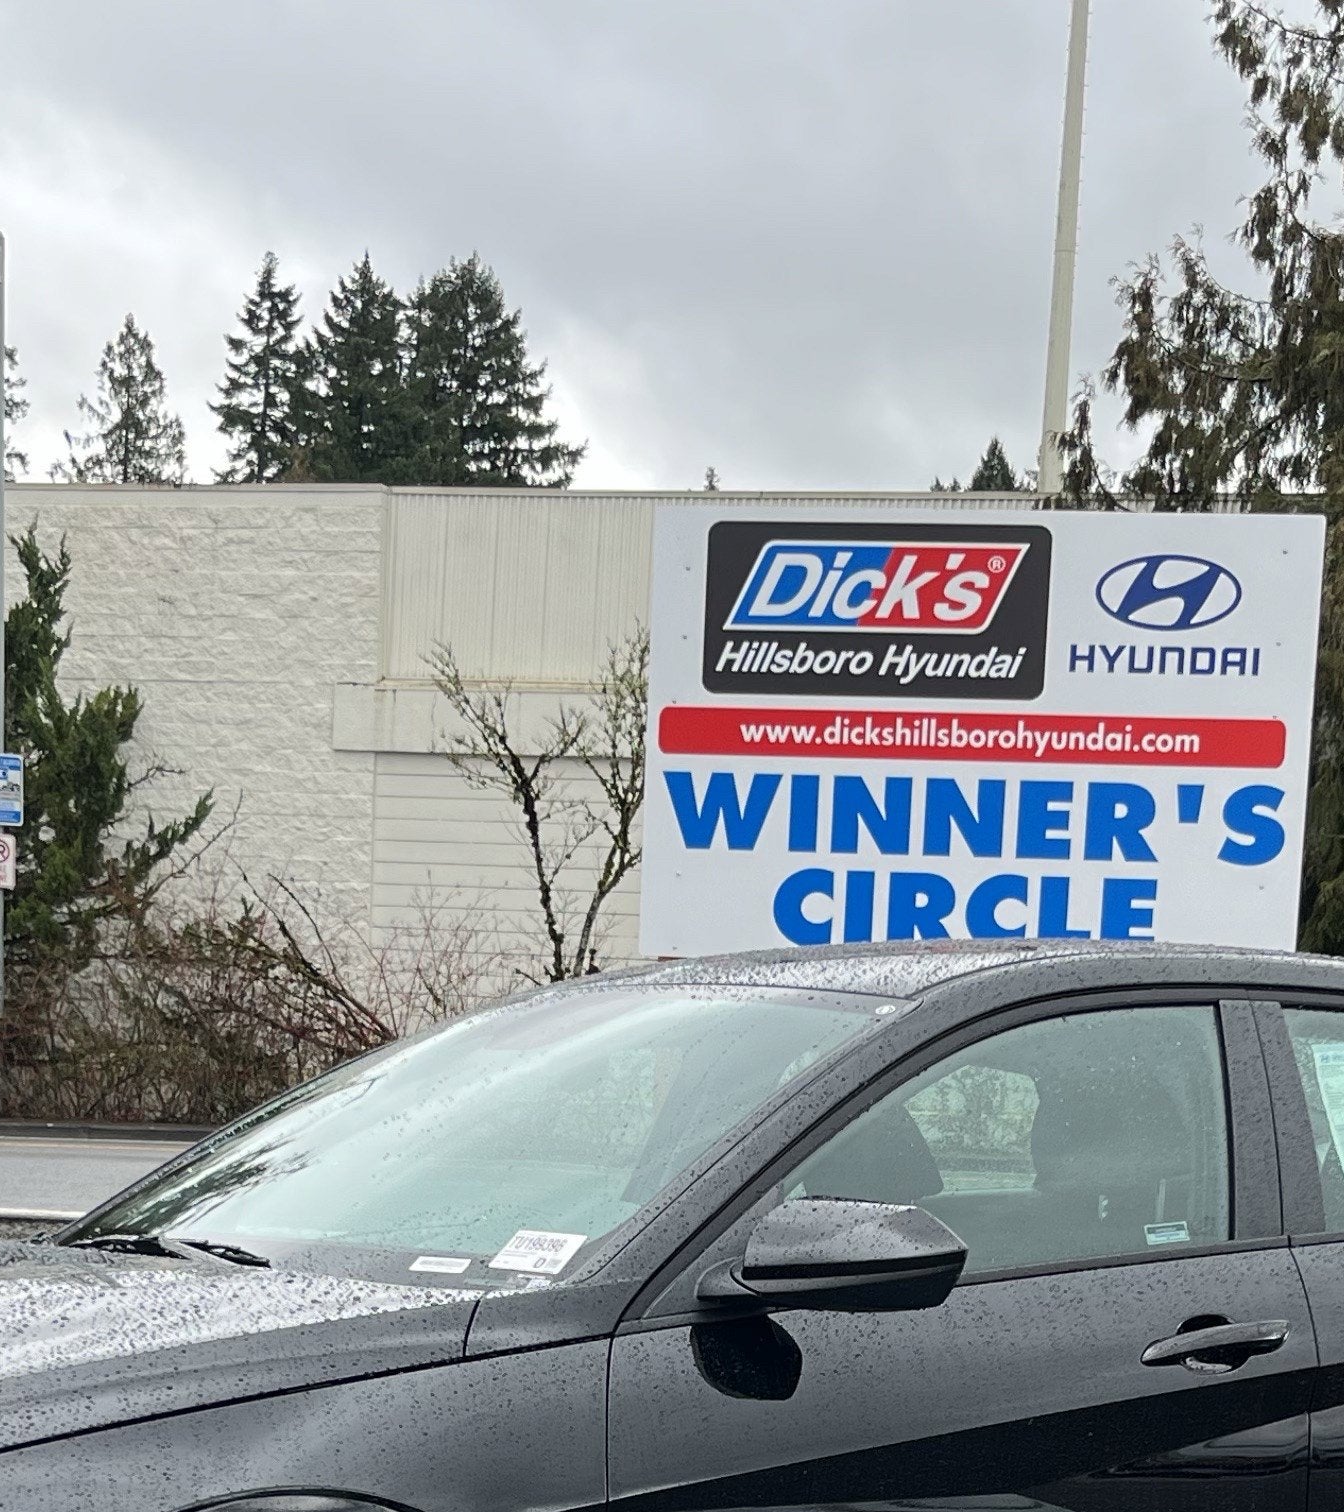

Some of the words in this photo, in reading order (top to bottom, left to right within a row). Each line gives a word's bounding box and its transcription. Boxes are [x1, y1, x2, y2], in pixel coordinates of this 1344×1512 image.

[748, 551, 990, 622] Dick's
[715, 640, 874, 675] Hillsboro
[878, 643, 1027, 685] Hyundai
[1068, 644, 1260, 677] HYUNDAI
[739, 716, 1200, 757] www.dickshillsborohyundai.com
[662, 771, 1288, 867] WINNER'S
[772, 867, 1158, 947] CIRCLE
